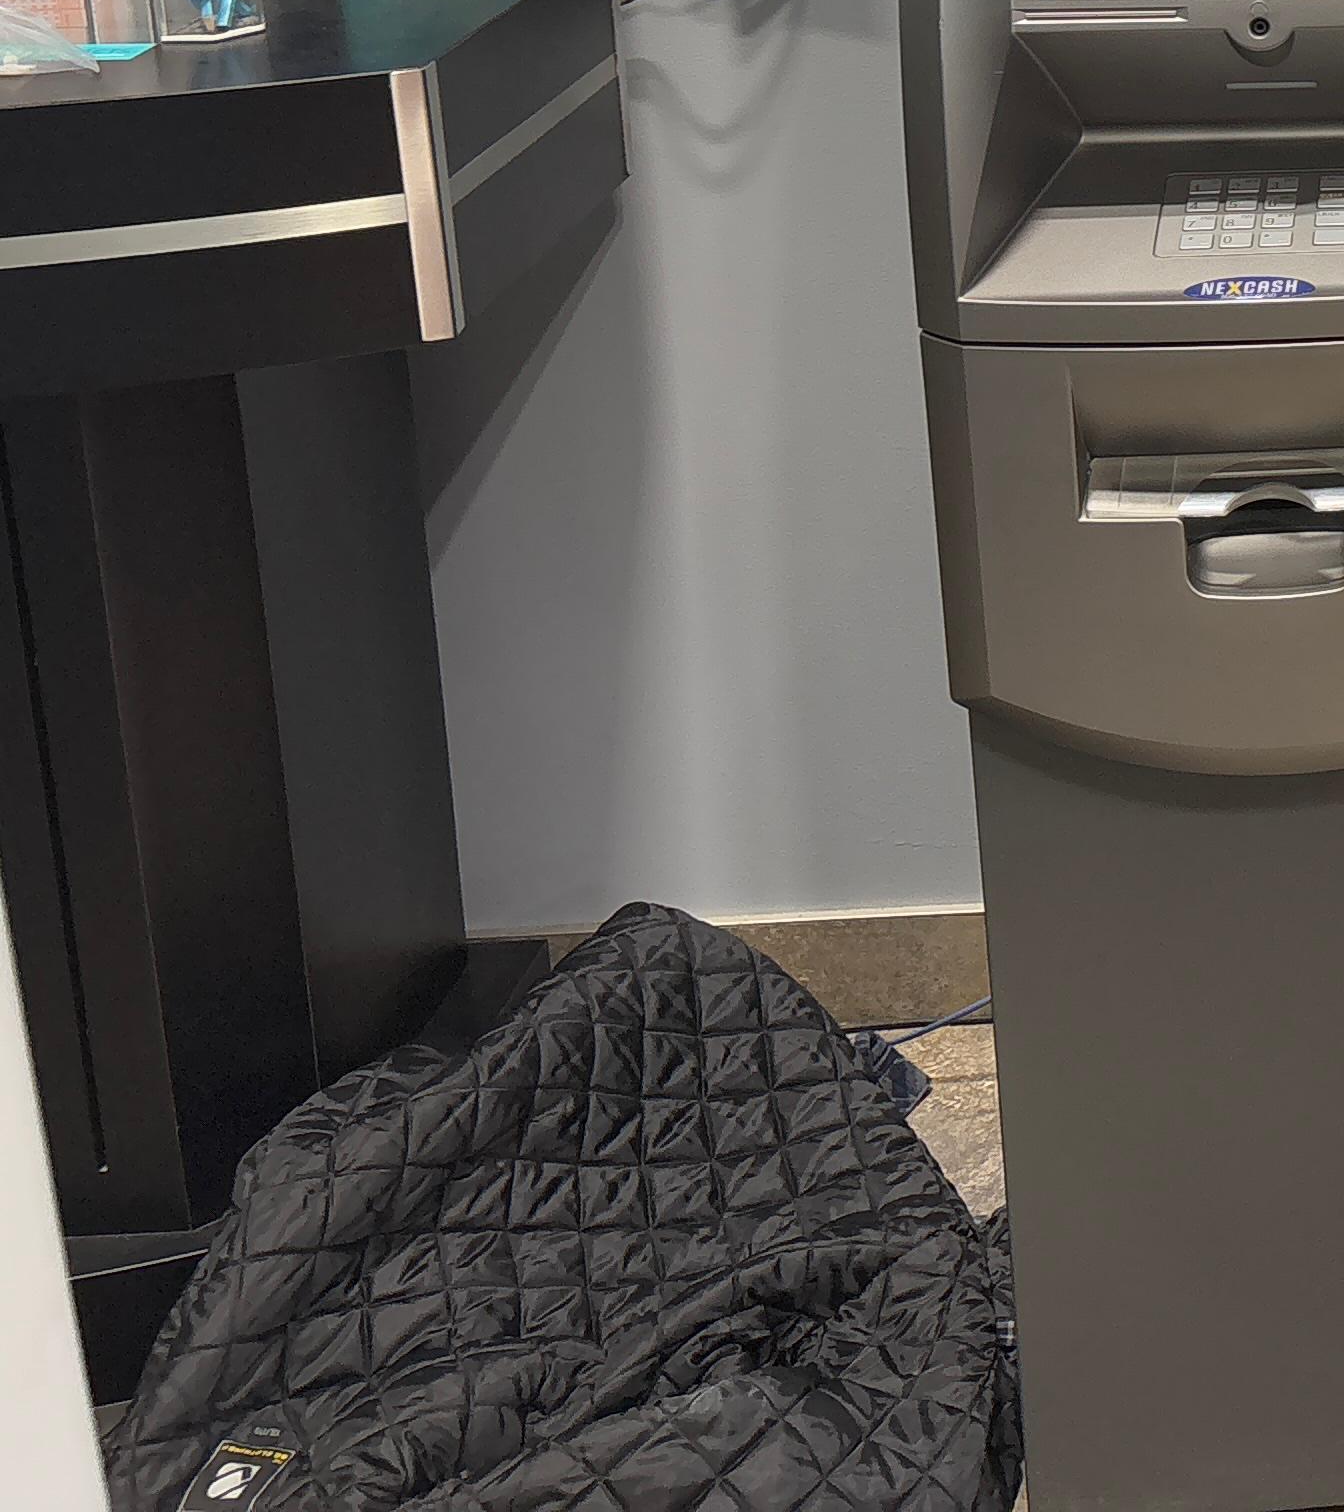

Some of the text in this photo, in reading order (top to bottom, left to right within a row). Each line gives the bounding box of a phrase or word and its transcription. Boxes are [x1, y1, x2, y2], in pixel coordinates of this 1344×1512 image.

[1187, 217, 1275, 228] 7 8 9
[1200, 278, 1299, 297] NEXCASH
